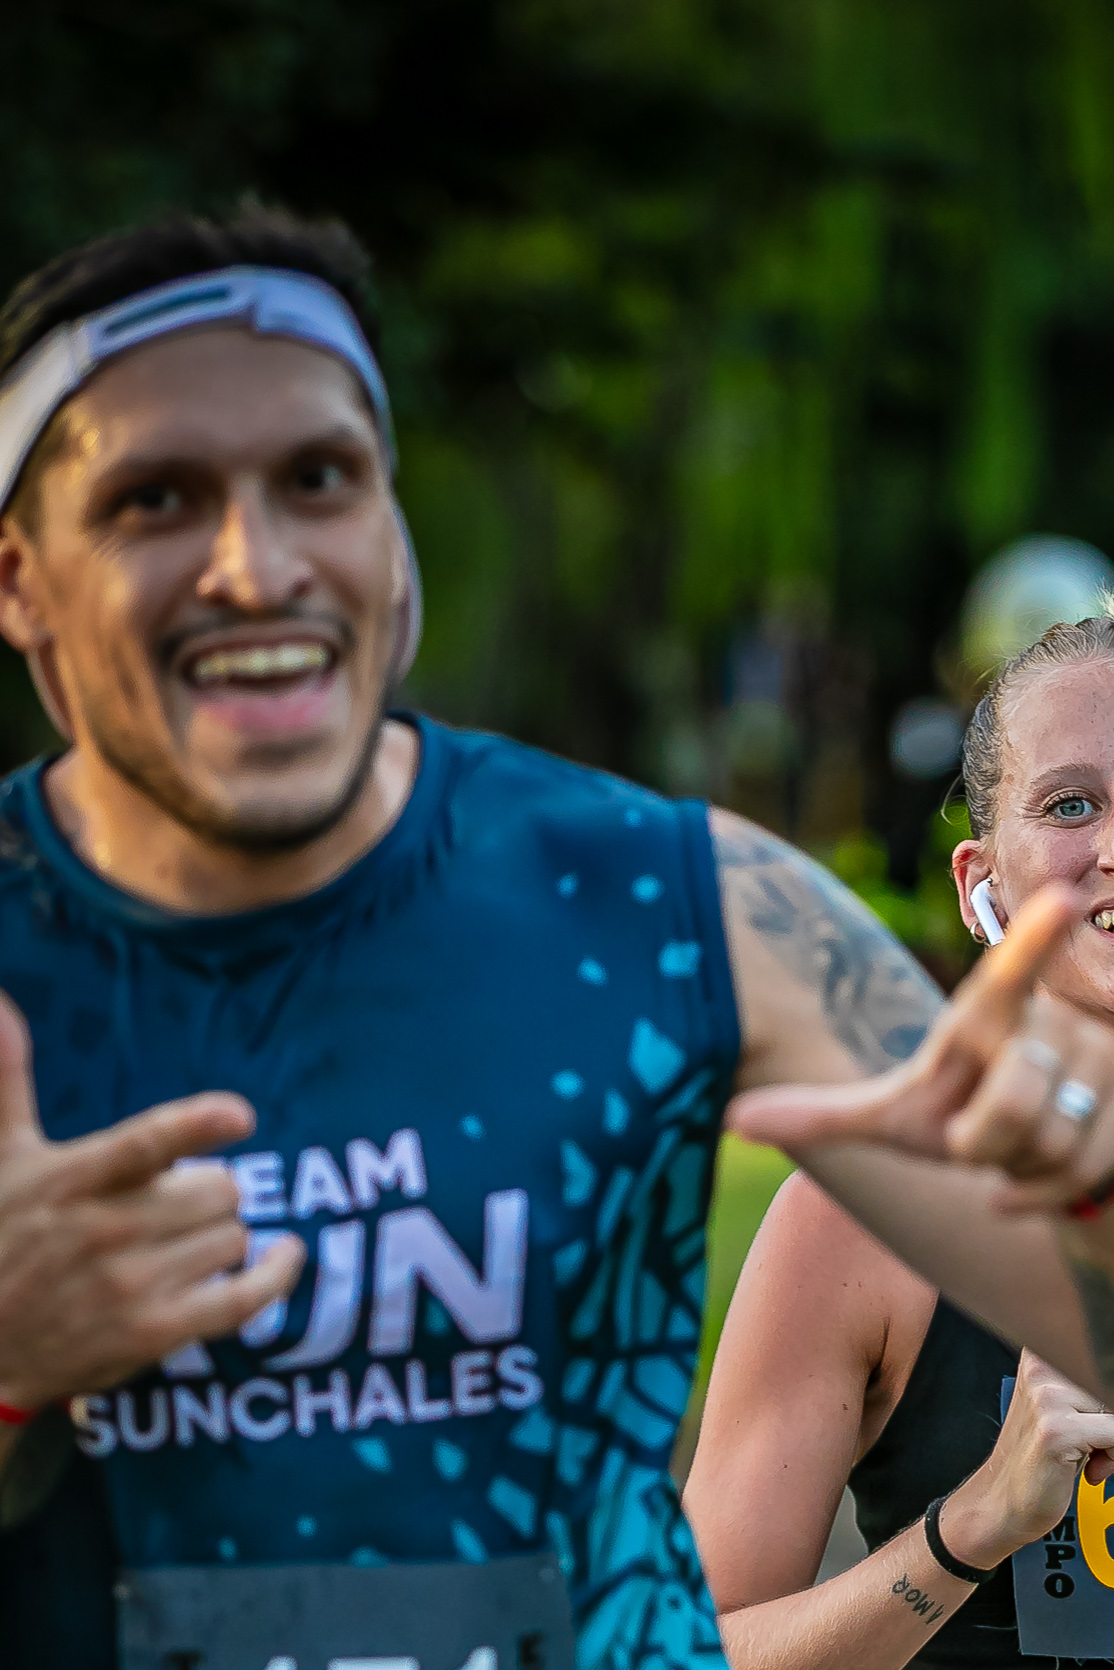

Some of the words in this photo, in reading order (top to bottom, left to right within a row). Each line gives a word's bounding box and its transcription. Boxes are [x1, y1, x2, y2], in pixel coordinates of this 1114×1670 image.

[162, 1188, 530, 1381] UN
[72, 1345, 542, 1457] SUNCHALES
[1043, 1514, 1078, 1599] MPO
